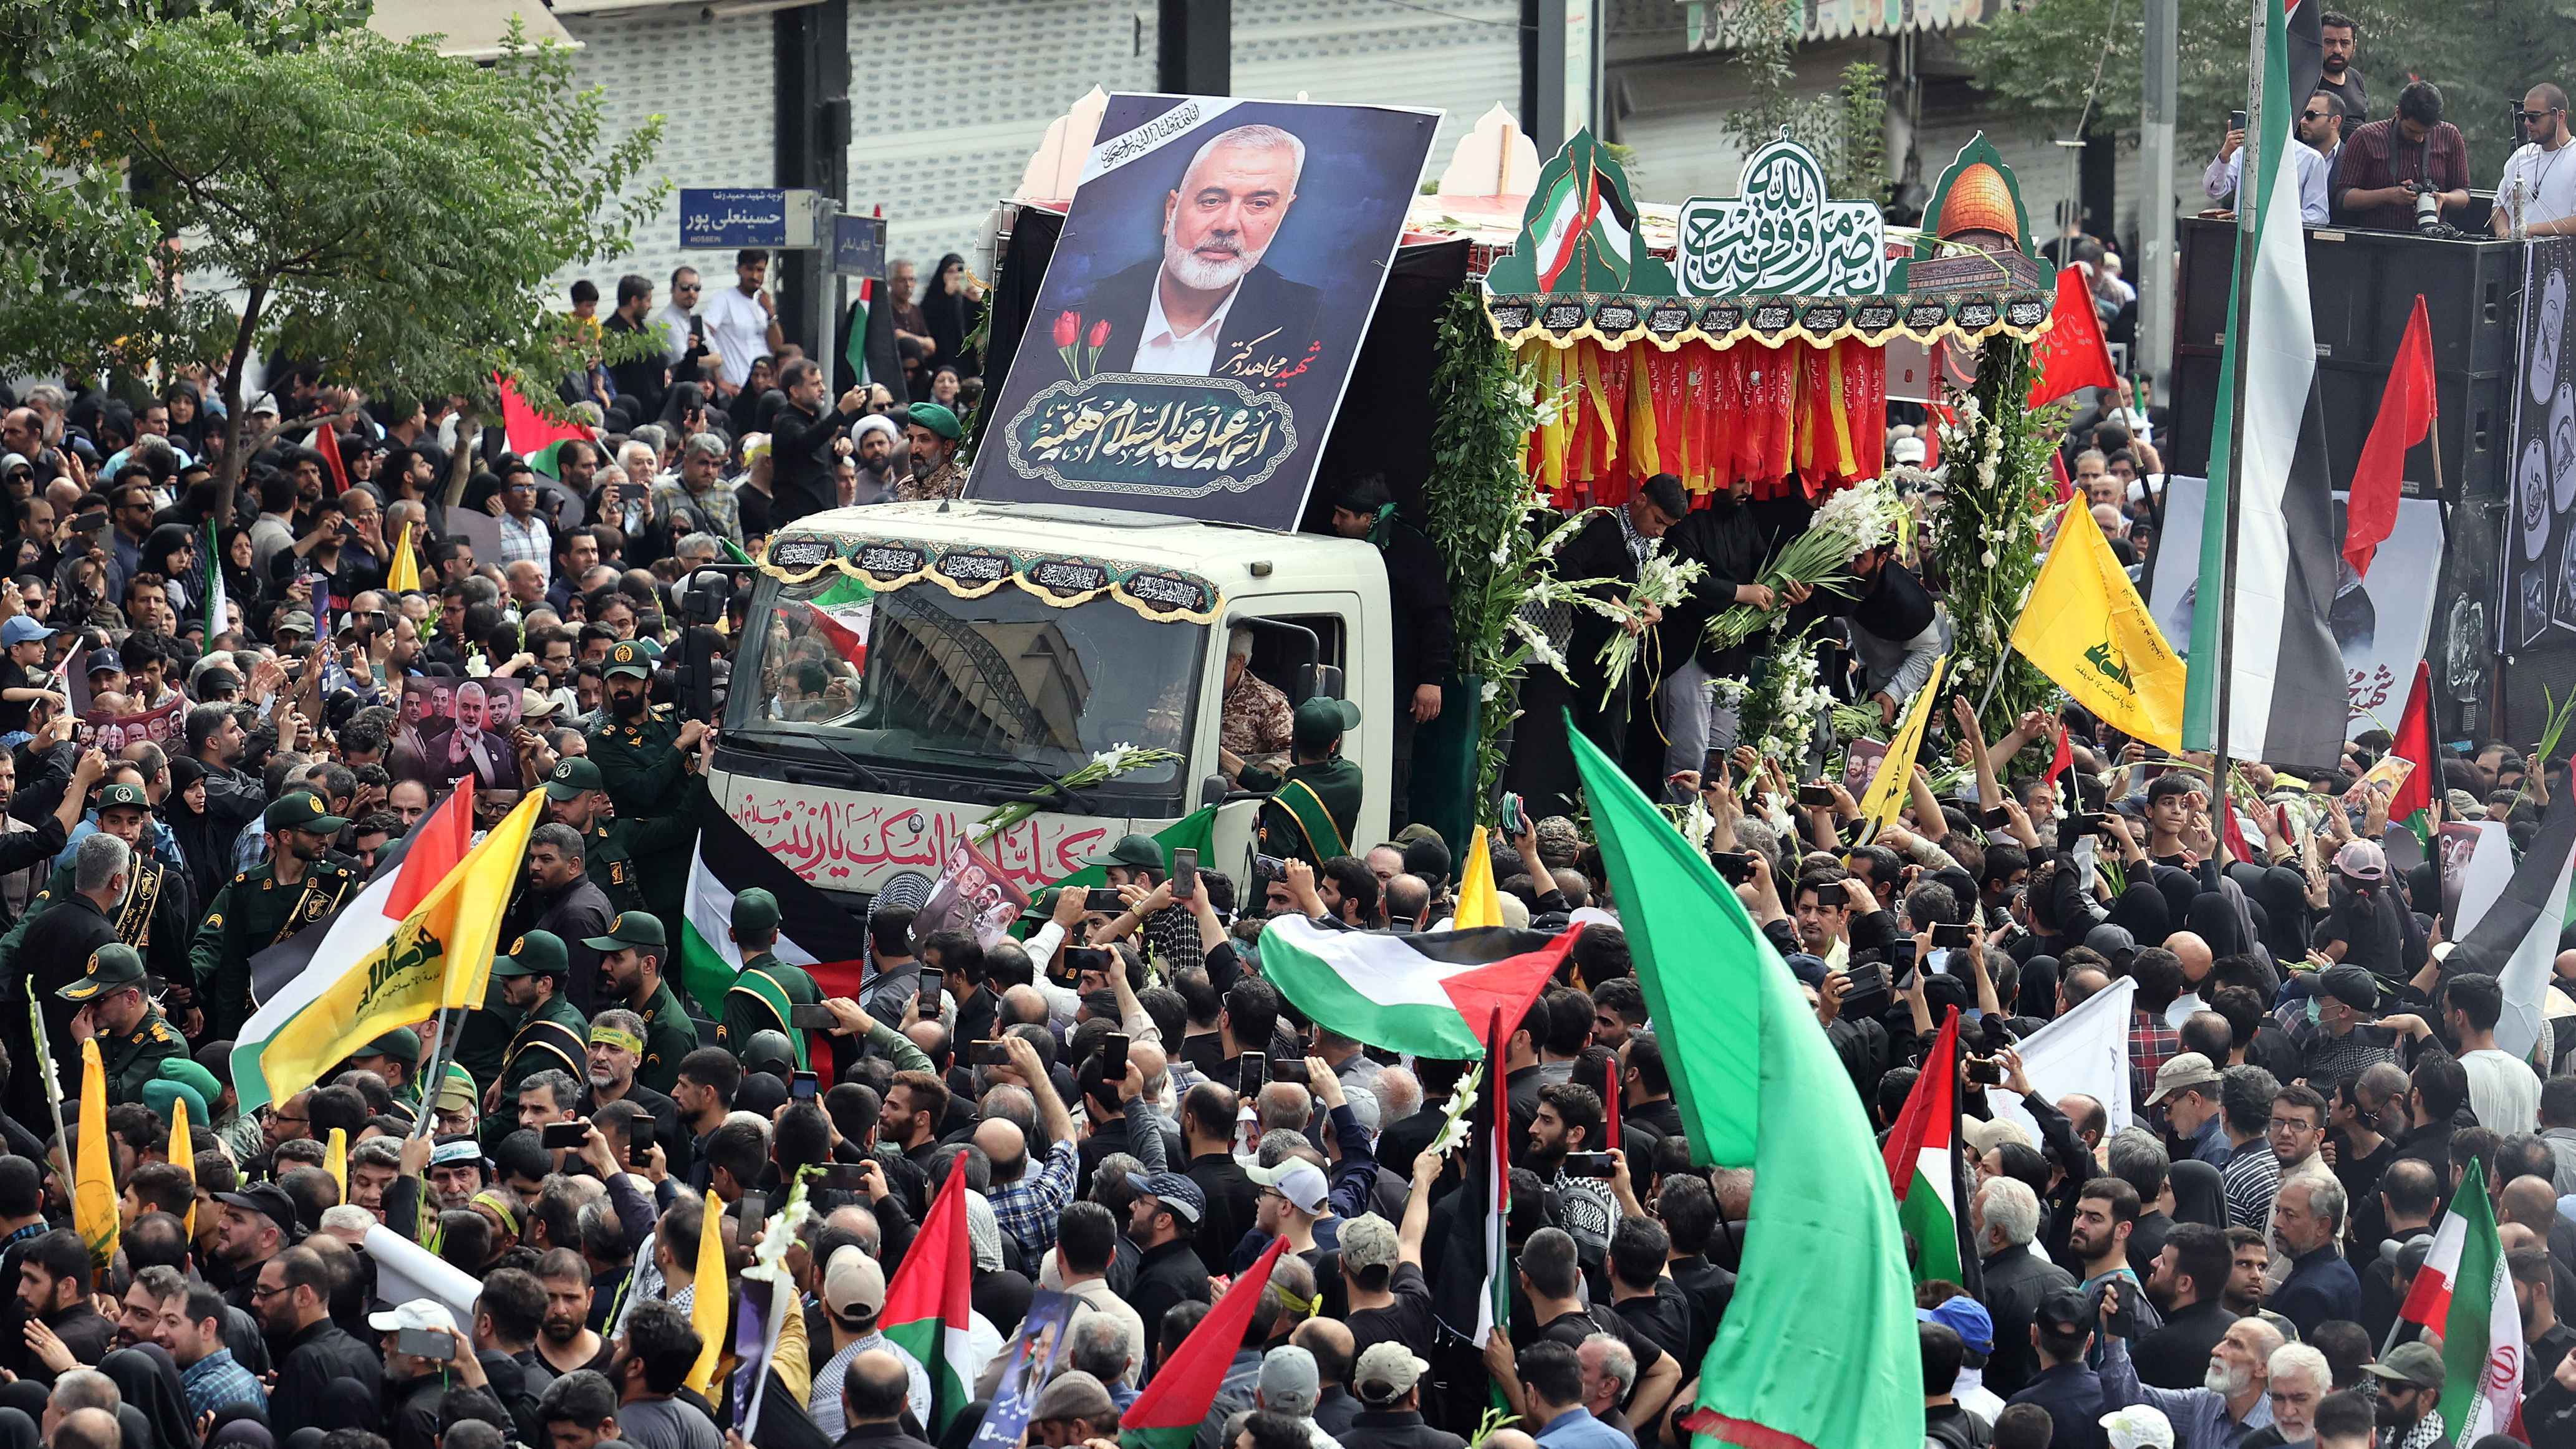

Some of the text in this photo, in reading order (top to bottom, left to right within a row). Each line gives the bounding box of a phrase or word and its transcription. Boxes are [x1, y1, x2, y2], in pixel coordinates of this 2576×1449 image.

[746, 191, 766, 201] شهید
[686, 208, 781, 233] حسینعلی پور
[1217, 326, 1321, 388] شهید مجاهد دکتر
